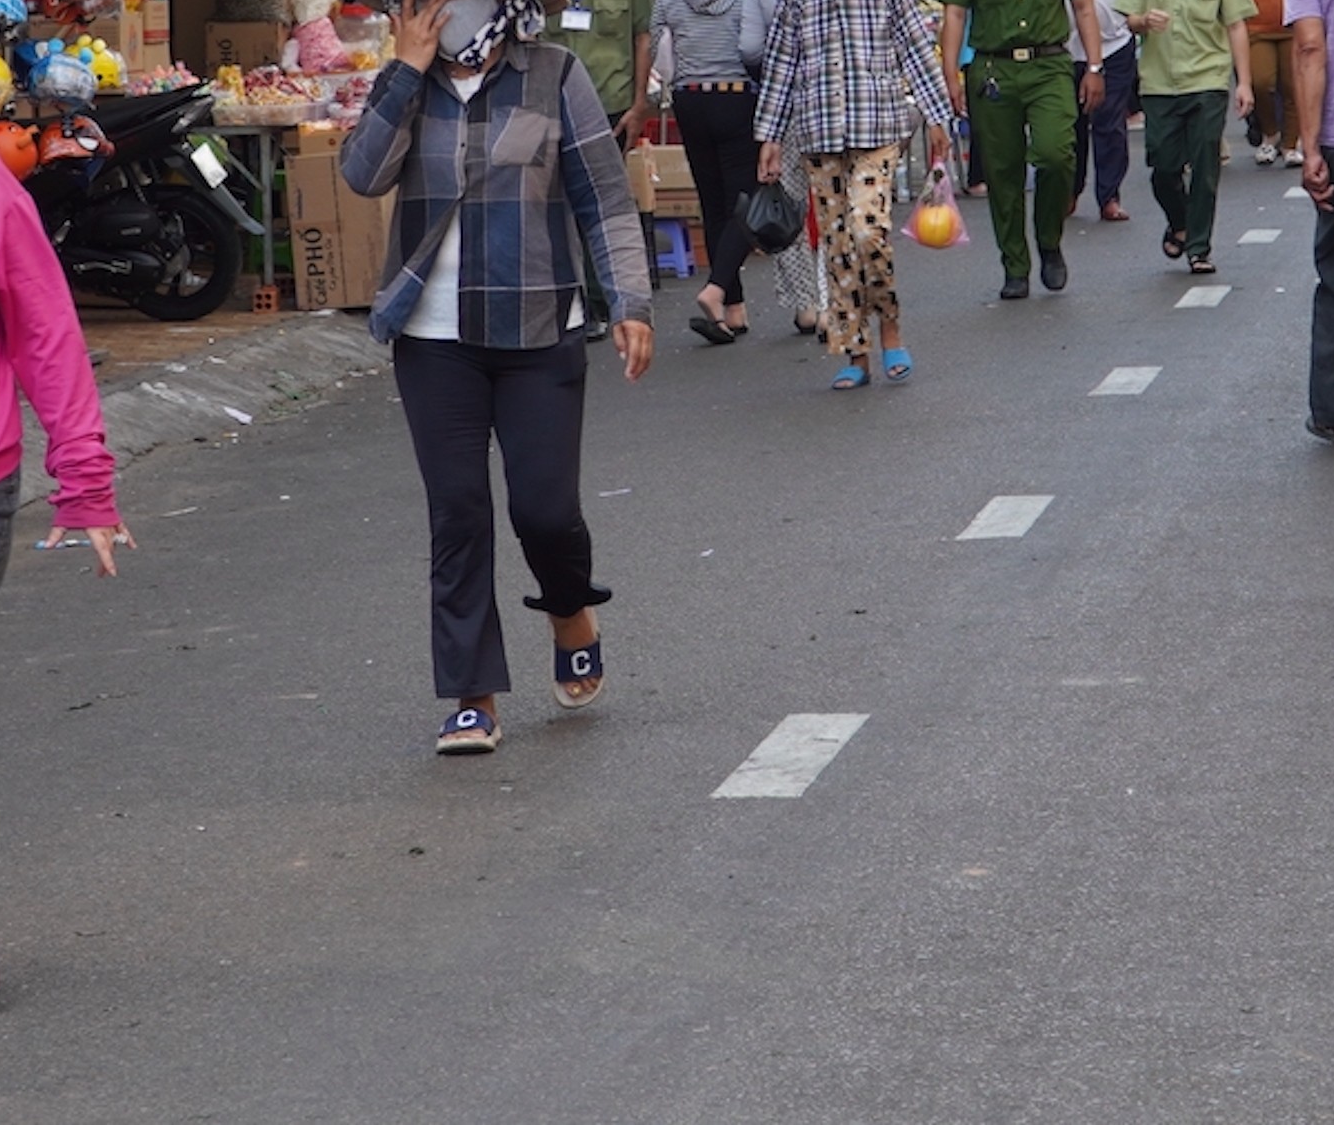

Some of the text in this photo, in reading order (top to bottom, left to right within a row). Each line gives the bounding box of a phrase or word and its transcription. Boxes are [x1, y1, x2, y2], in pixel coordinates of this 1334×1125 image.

[297, 227, 325, 277] PHỐ
[571, 649, 591, 675] C
[456, 708, 478, 728] C
